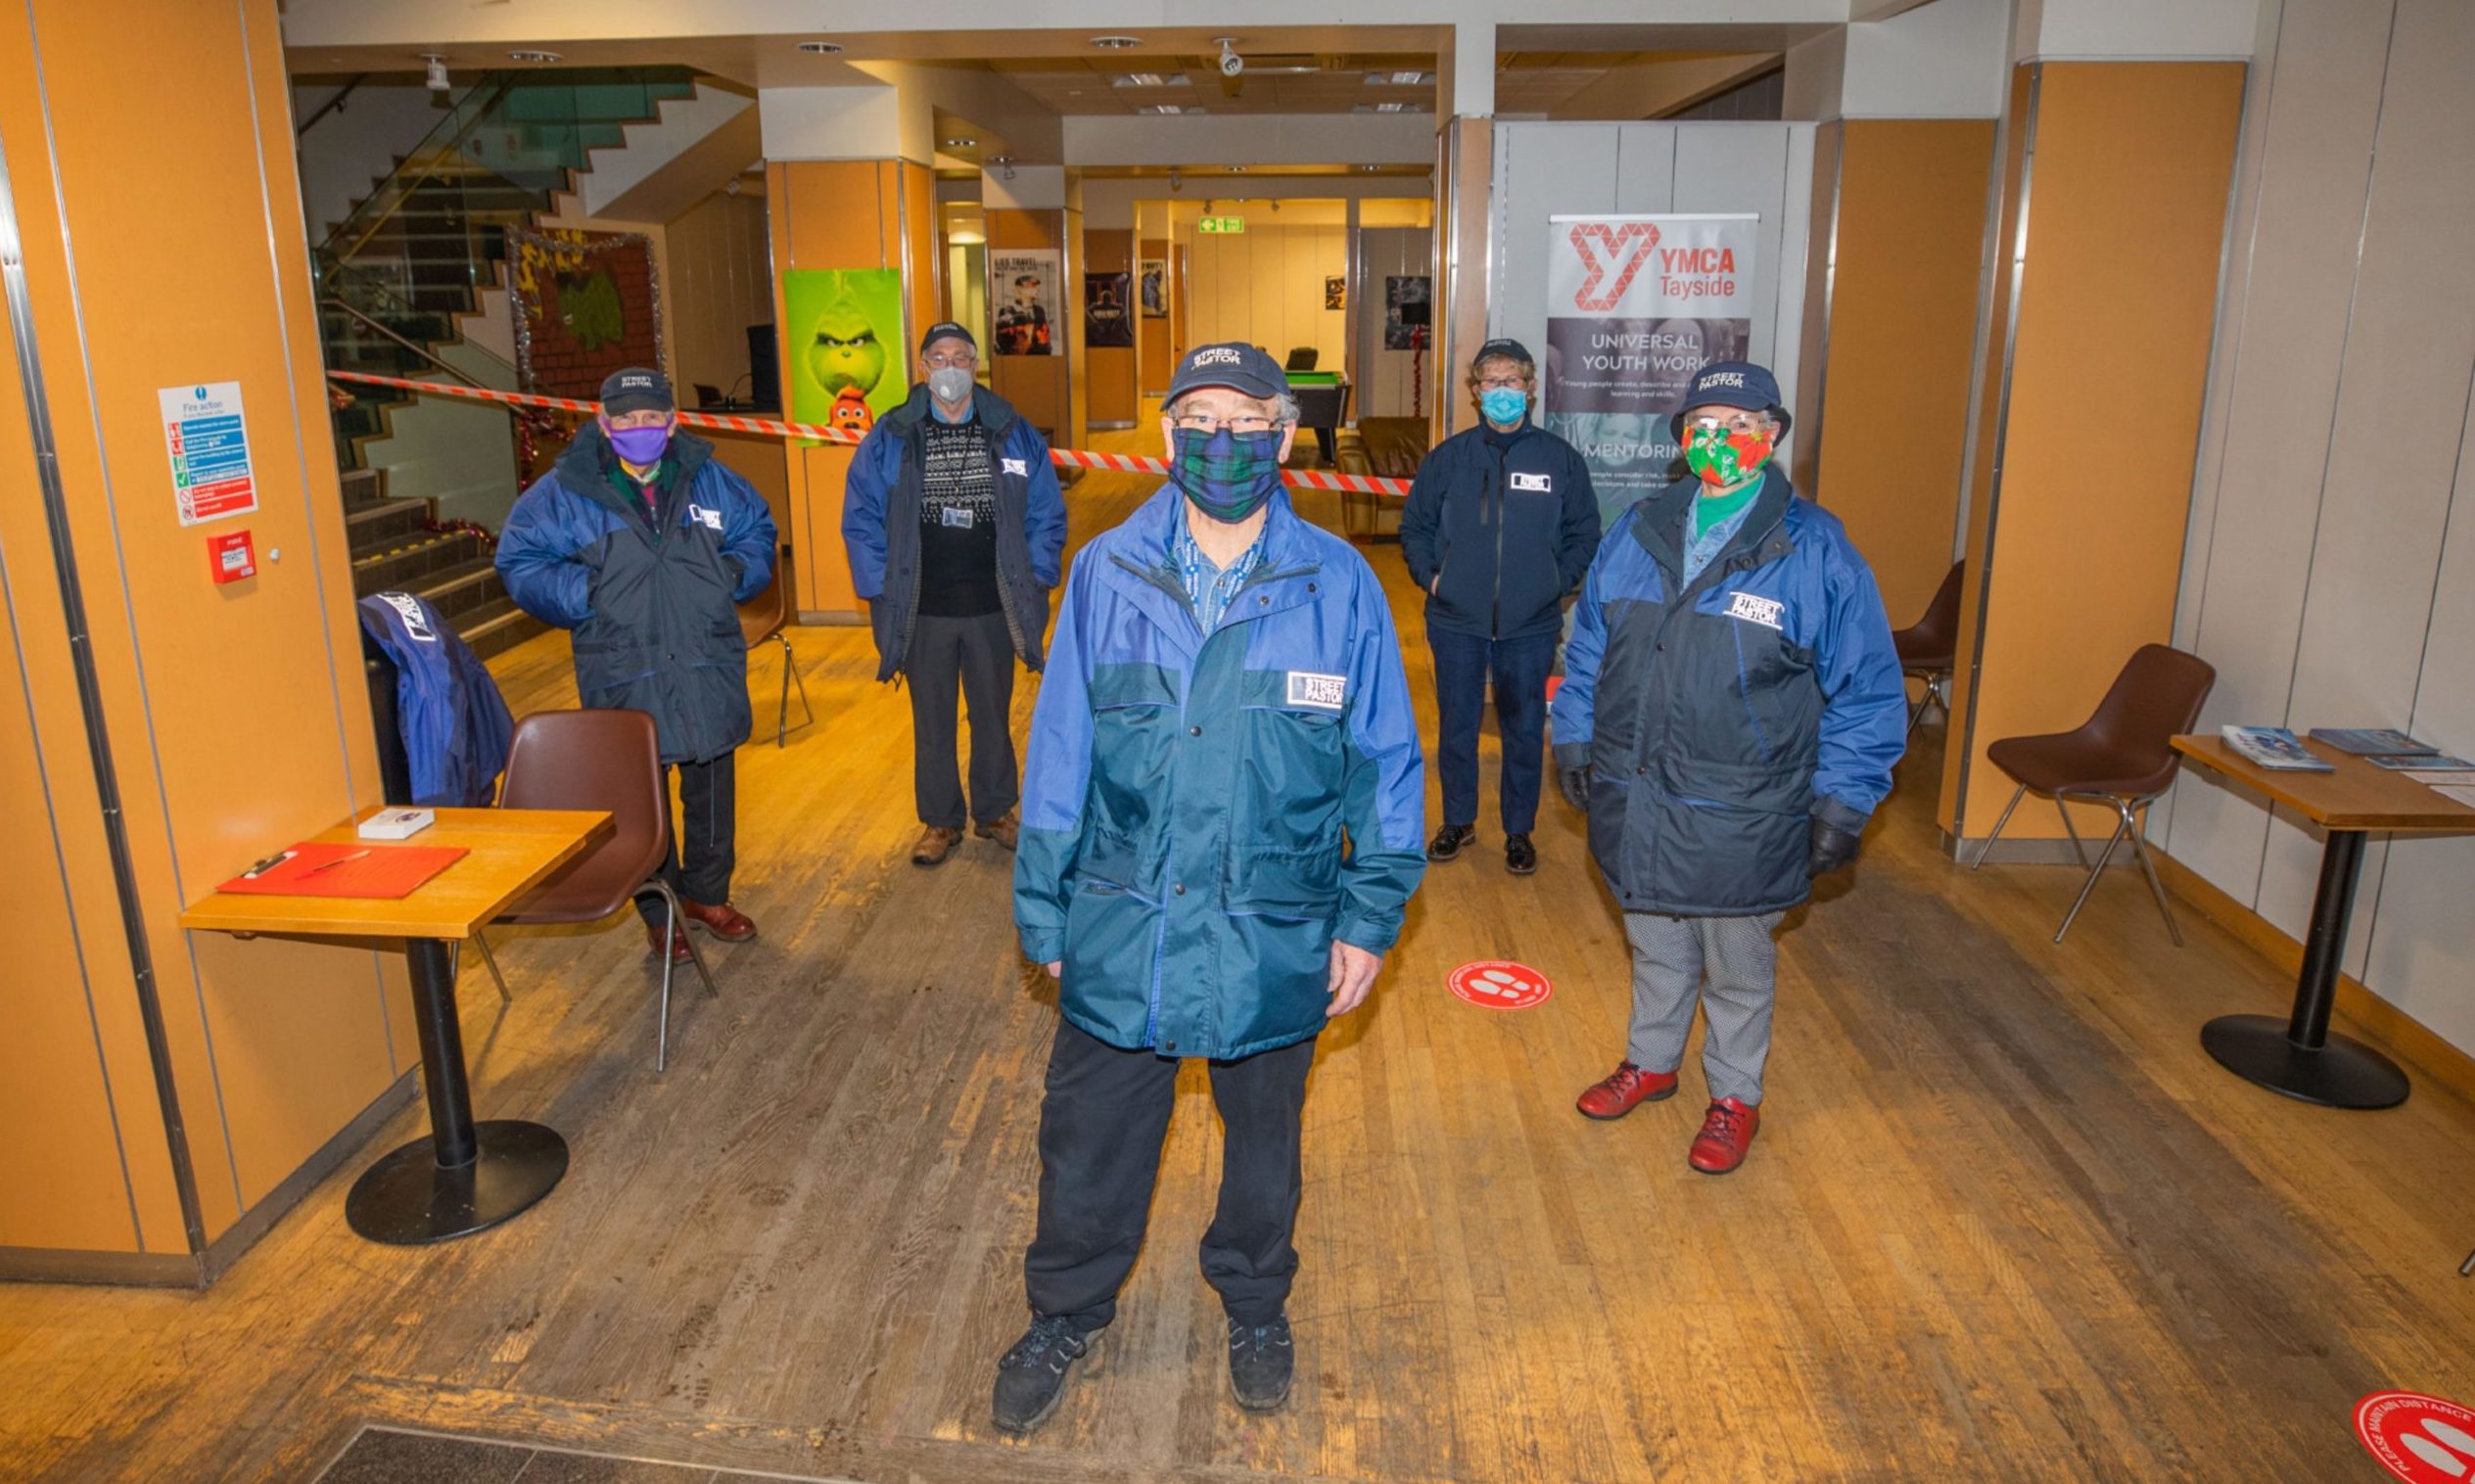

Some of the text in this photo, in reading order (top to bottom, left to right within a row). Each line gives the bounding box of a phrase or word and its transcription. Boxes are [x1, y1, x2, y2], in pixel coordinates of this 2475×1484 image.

[1660, 248, 1736, 274] YMCA
[1660, 275, 1735, 301] Tayside
[1591, 334, 1699, 349] UNIVERSAL
[1193, 348, 1241, 361] STREET
[1582, 355, 1711, 371] YOUTH WORK
[1699, 378, 1744, 392] PASTOR
[1700, 372, 1746, 382] STREET
[183, 401, 223, 412] Fire action
[1735, 595, 1780, 615] STREET
[1732, 604, 1776, 625] PASTOR
[1305, 677, 1345, 693] STREET
[2367, 1399, 2472, 1472] PLEASE MAINTAIN DISTANCE
